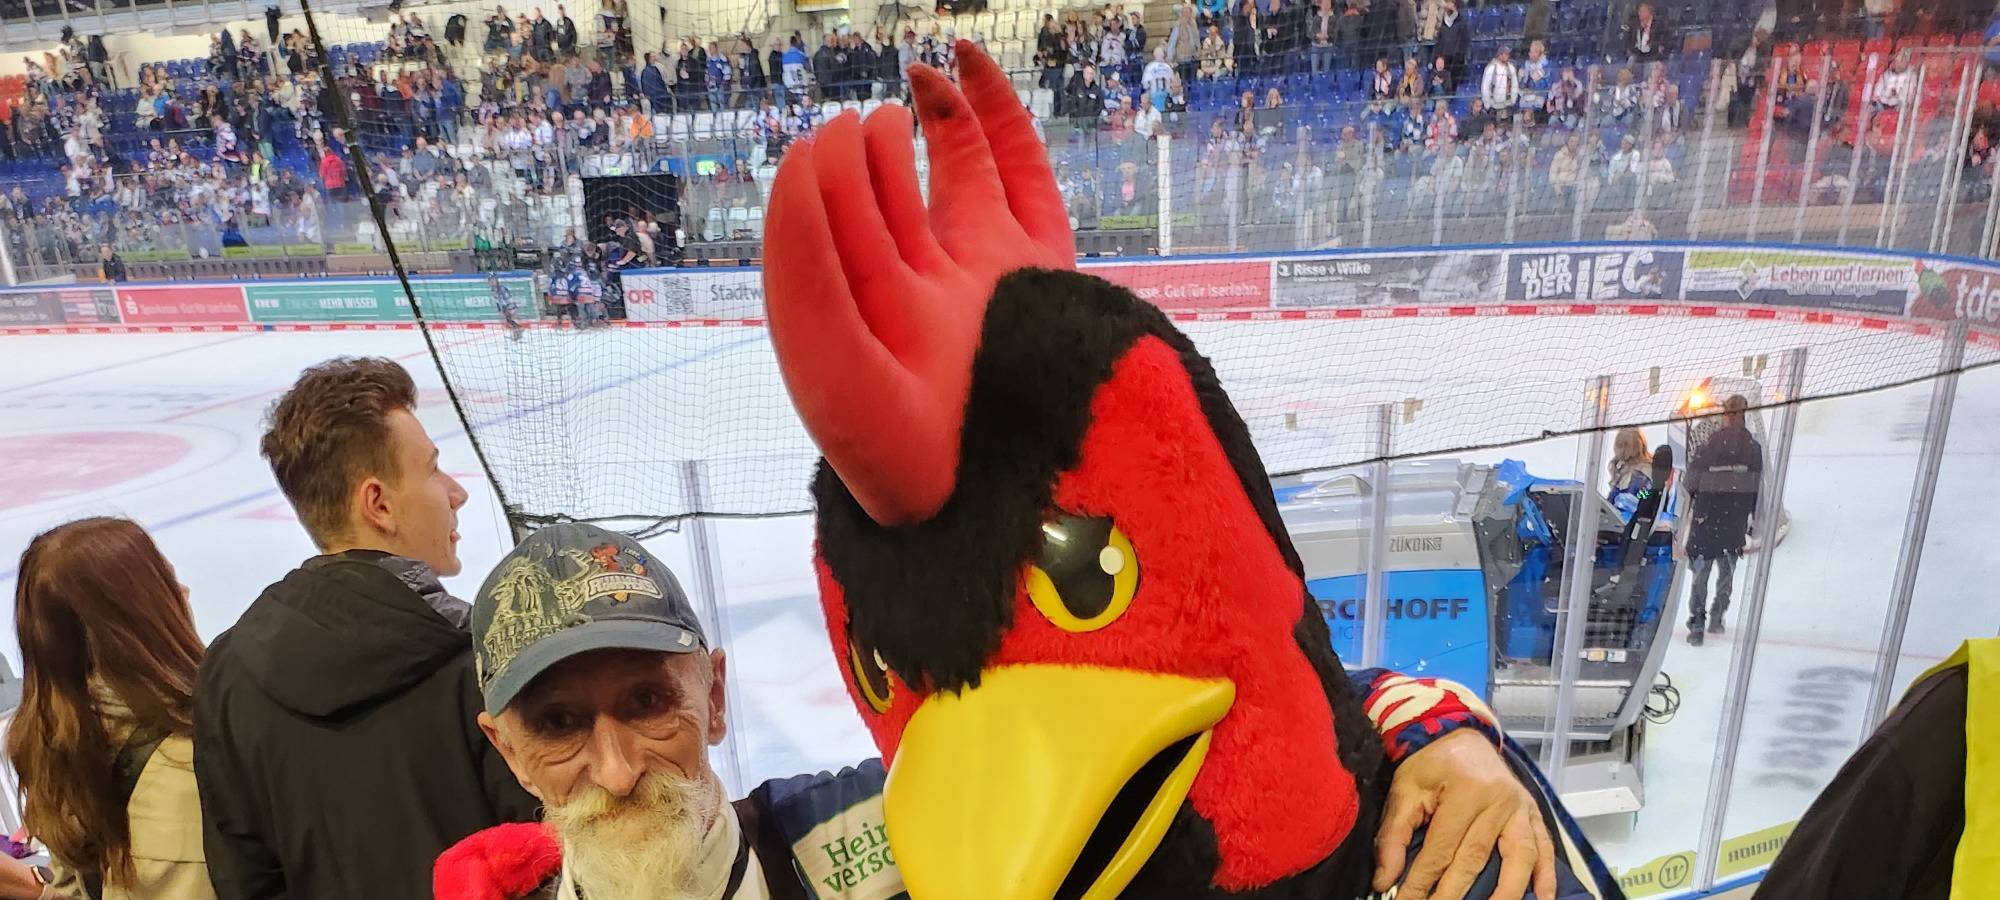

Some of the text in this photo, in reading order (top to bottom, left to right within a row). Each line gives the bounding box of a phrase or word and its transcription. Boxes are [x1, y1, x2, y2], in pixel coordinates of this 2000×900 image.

[1293, 264, 1327, 276] Risse
[1336, 261, 1371, 275] Wilke
[1520, 254, 1570, 284] NUR
[1575, 248, 1653, 300] IEC
[1770, 264, 1904, 283] Leben und lernen
[1164, 283, 1185, 297] Gut
[1525, 272, 1572, 300] DER
[1318, 598, 1469, 619] RCHOFF
